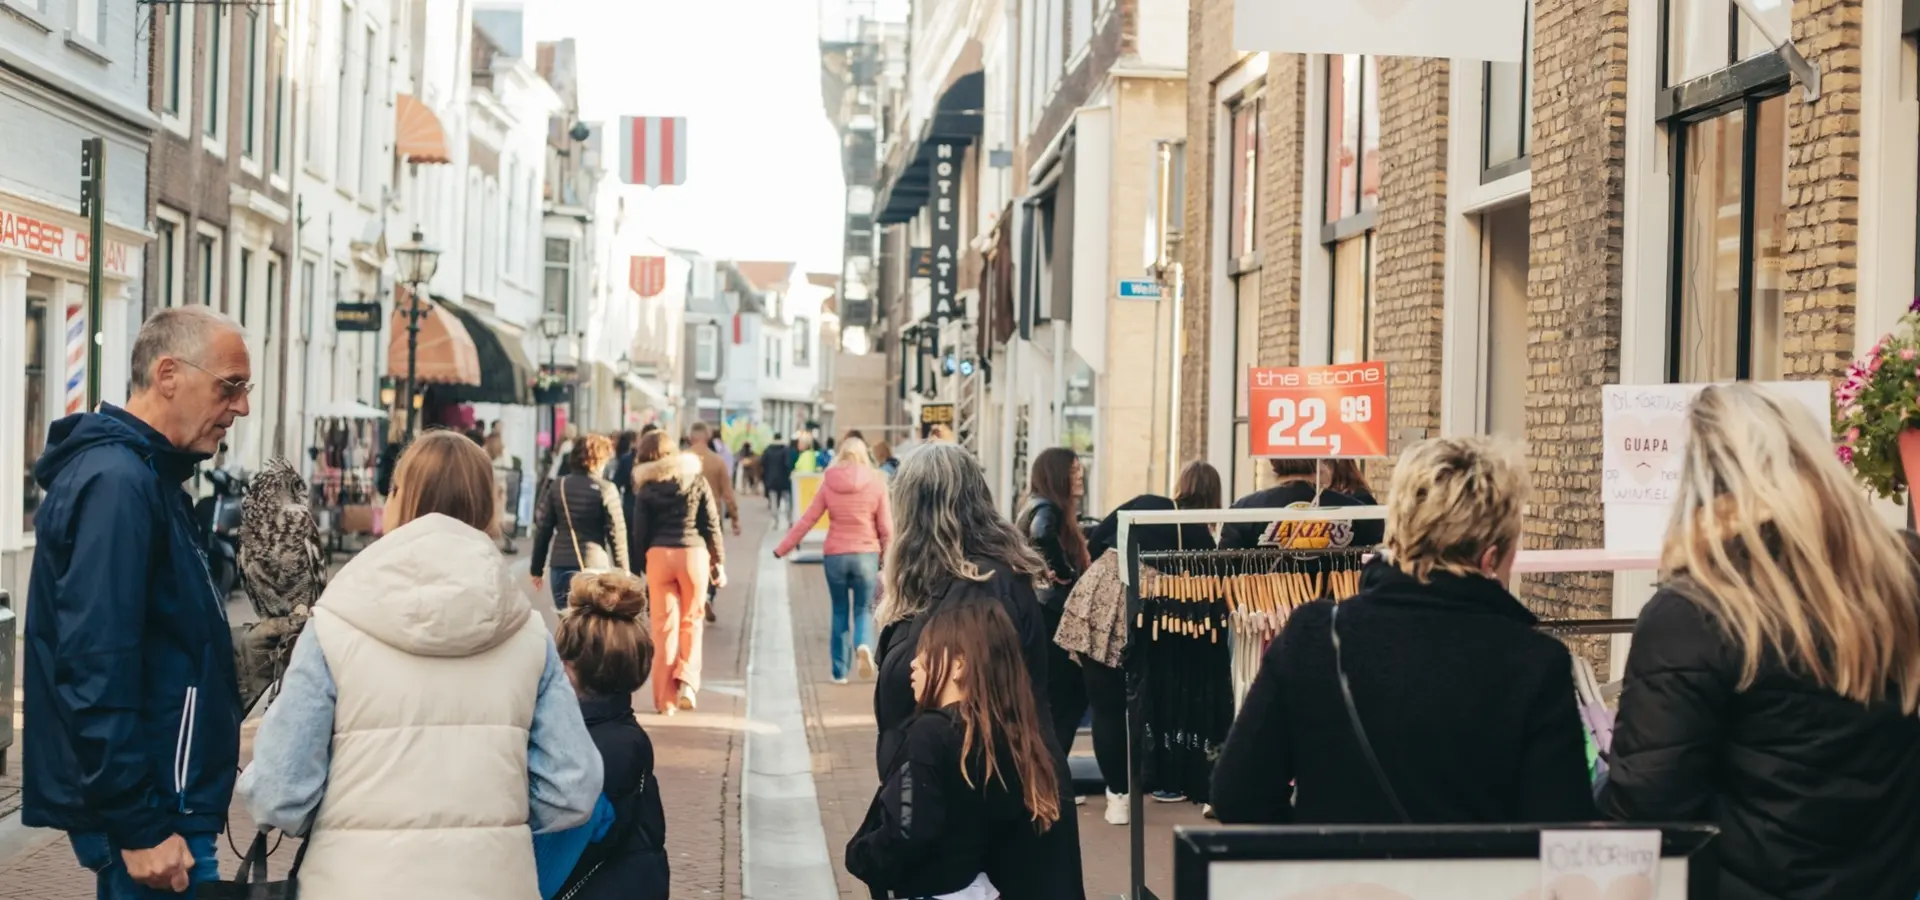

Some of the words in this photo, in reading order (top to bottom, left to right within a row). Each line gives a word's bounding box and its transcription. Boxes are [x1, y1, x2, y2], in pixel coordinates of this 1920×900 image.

[937, 144, 952, 230] HOTEL
[0, 211, 63, 257] ARBER
[1256, 370, 1299, 386] the
[1307, 368, 1380, 386] stone
[1624, 437, 1669, 453] GUAPA
[1612, 487, 1669, 501] WINKEL
[1263, 519, 1349, 547] LAKERS
